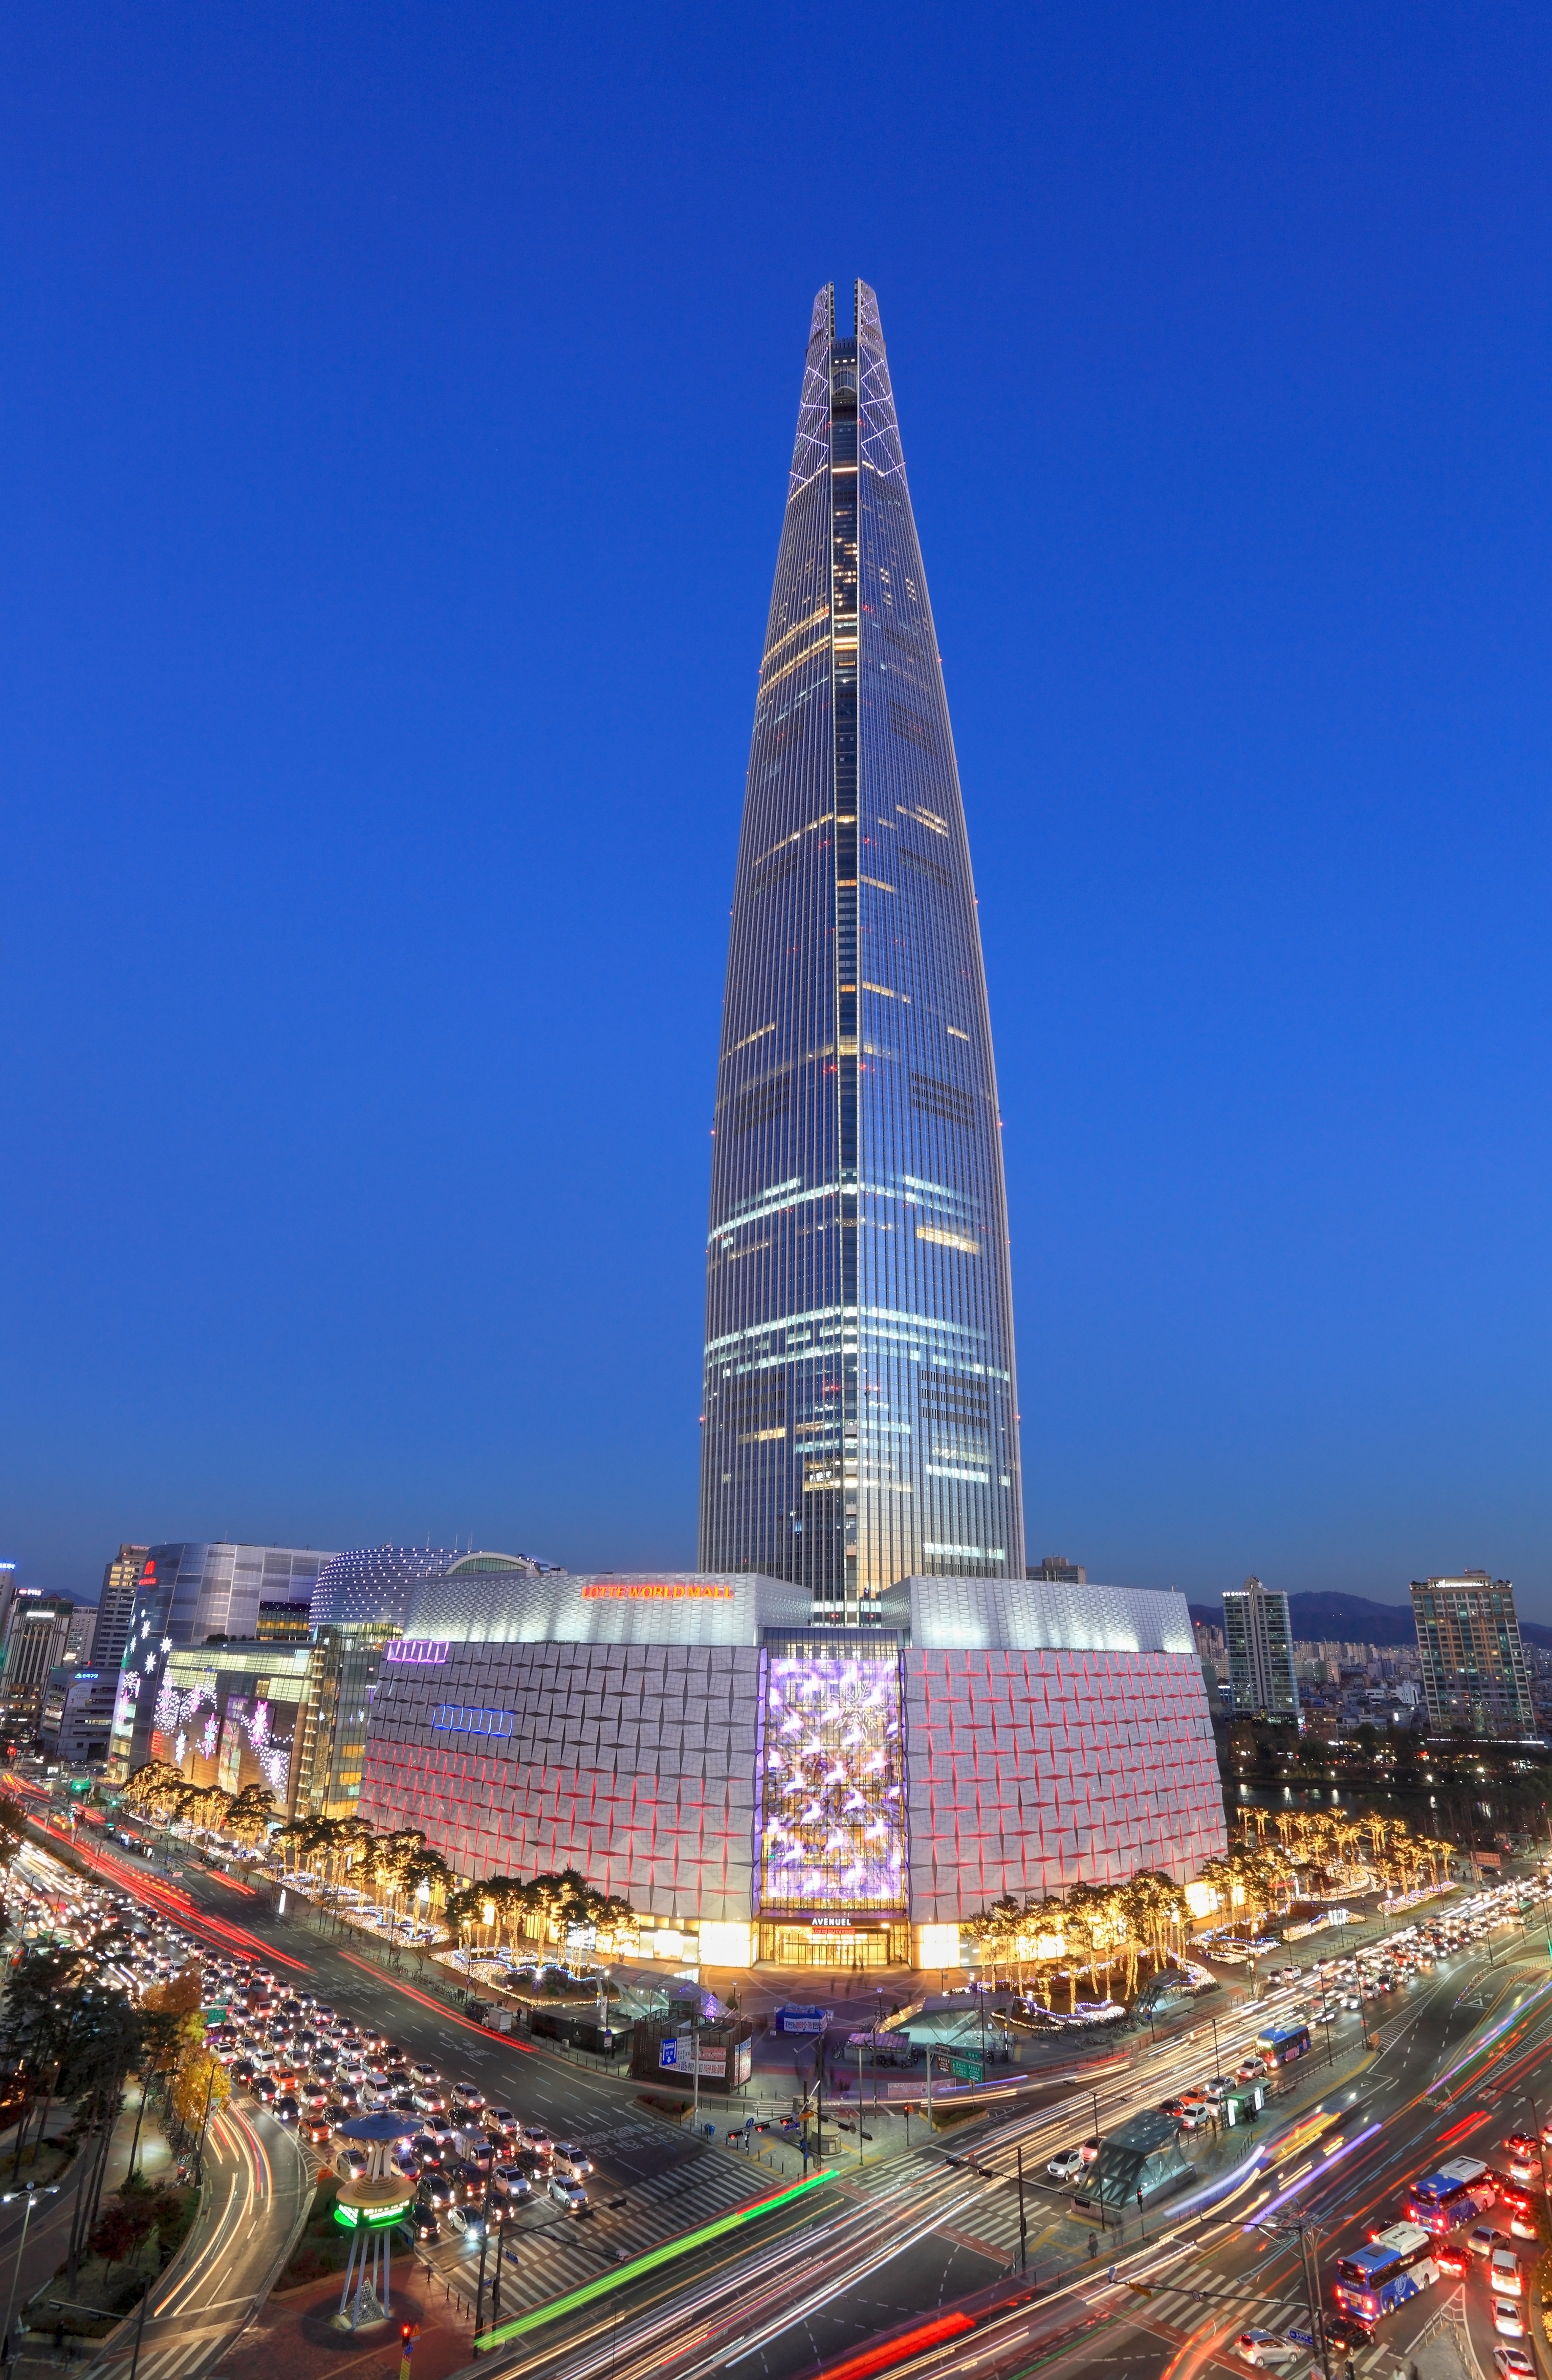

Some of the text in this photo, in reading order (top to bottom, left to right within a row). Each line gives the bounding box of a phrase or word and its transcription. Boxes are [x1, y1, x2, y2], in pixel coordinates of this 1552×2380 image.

[582, 1585, 734, 1598] LOTTE WORLD MALL
[812, 1918, 851, 1926] AVENUEL
